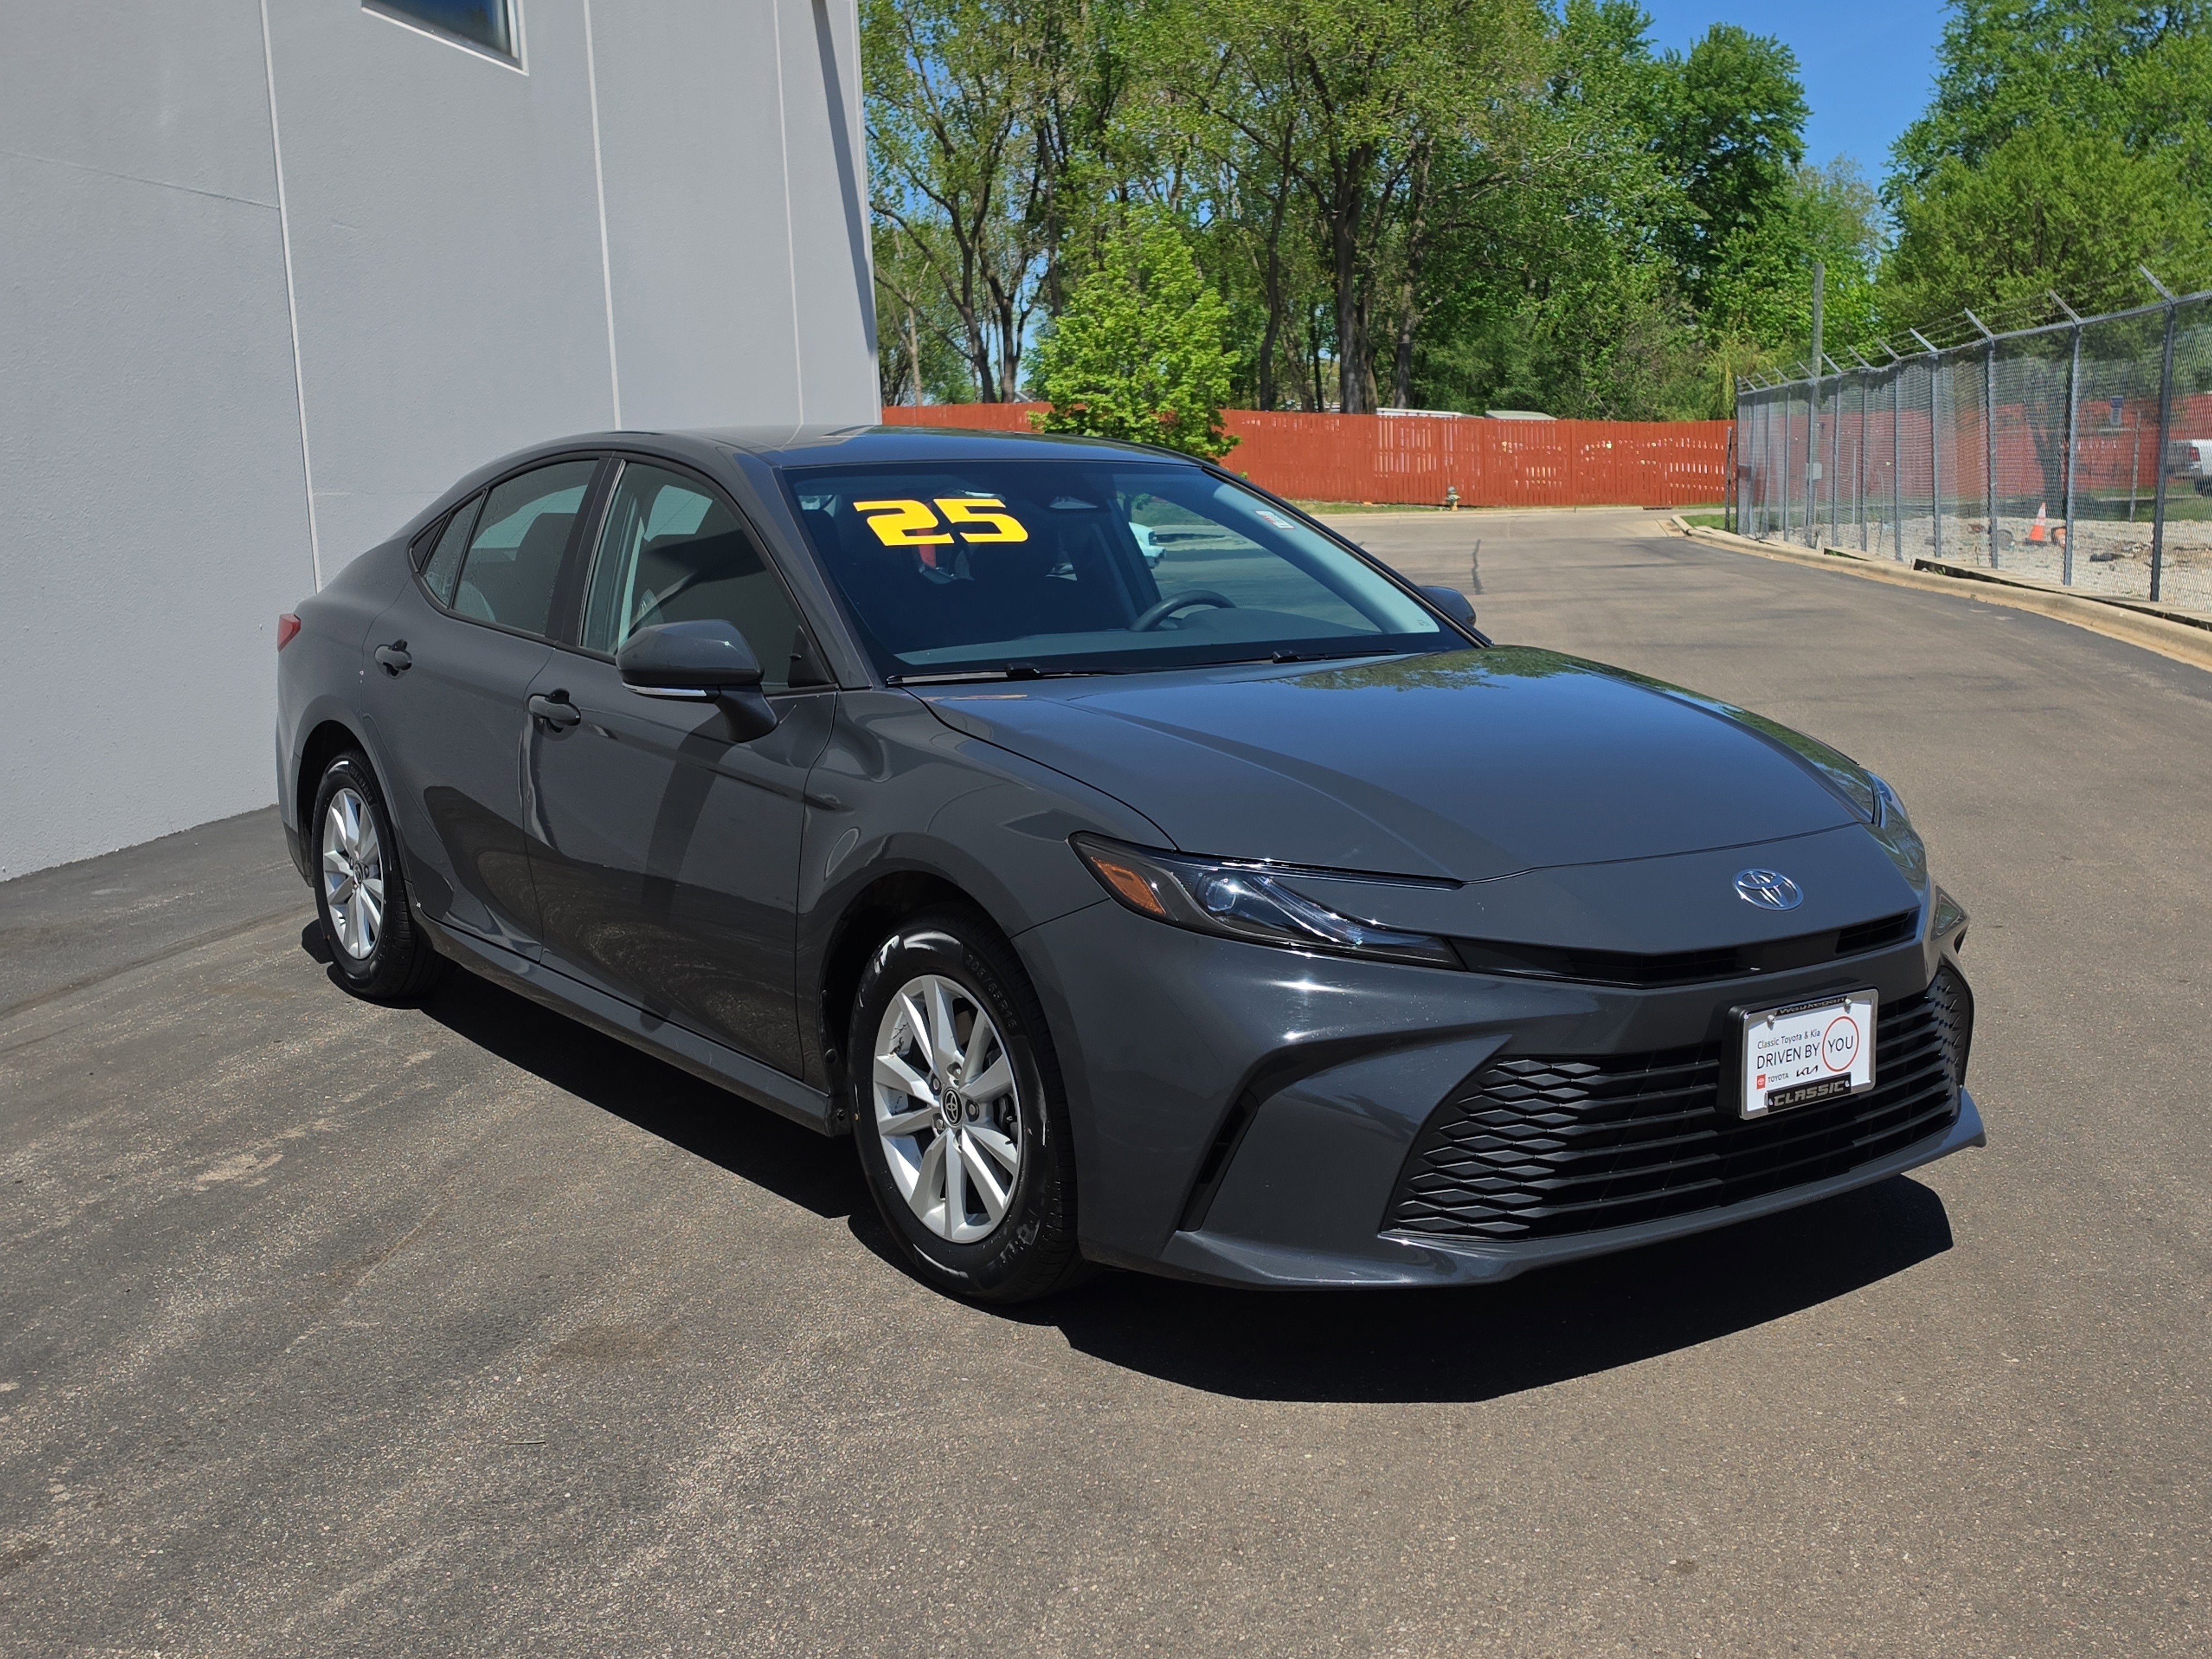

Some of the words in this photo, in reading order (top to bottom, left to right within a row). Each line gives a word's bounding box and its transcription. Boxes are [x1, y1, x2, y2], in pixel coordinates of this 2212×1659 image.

[853, 499, 1028, 546] 25
[1757, 1038, 1779, 1050] Classic
[1781, 1033, 1802, 1045] Toyota
[1804, 1031, 1808, 1039] &
[1810, 1028, 1821, 1038] Kia
[1757, 1046, 1801, 1069] DRIVEN
[1805, 1042, 1821, 1058] BY
[1828, 1036, 1854, 1053] YOU
[1767, 1072, 1789, 1083] TOYOTA
[1773, 1079, 1845, 1107] CLASSIC
